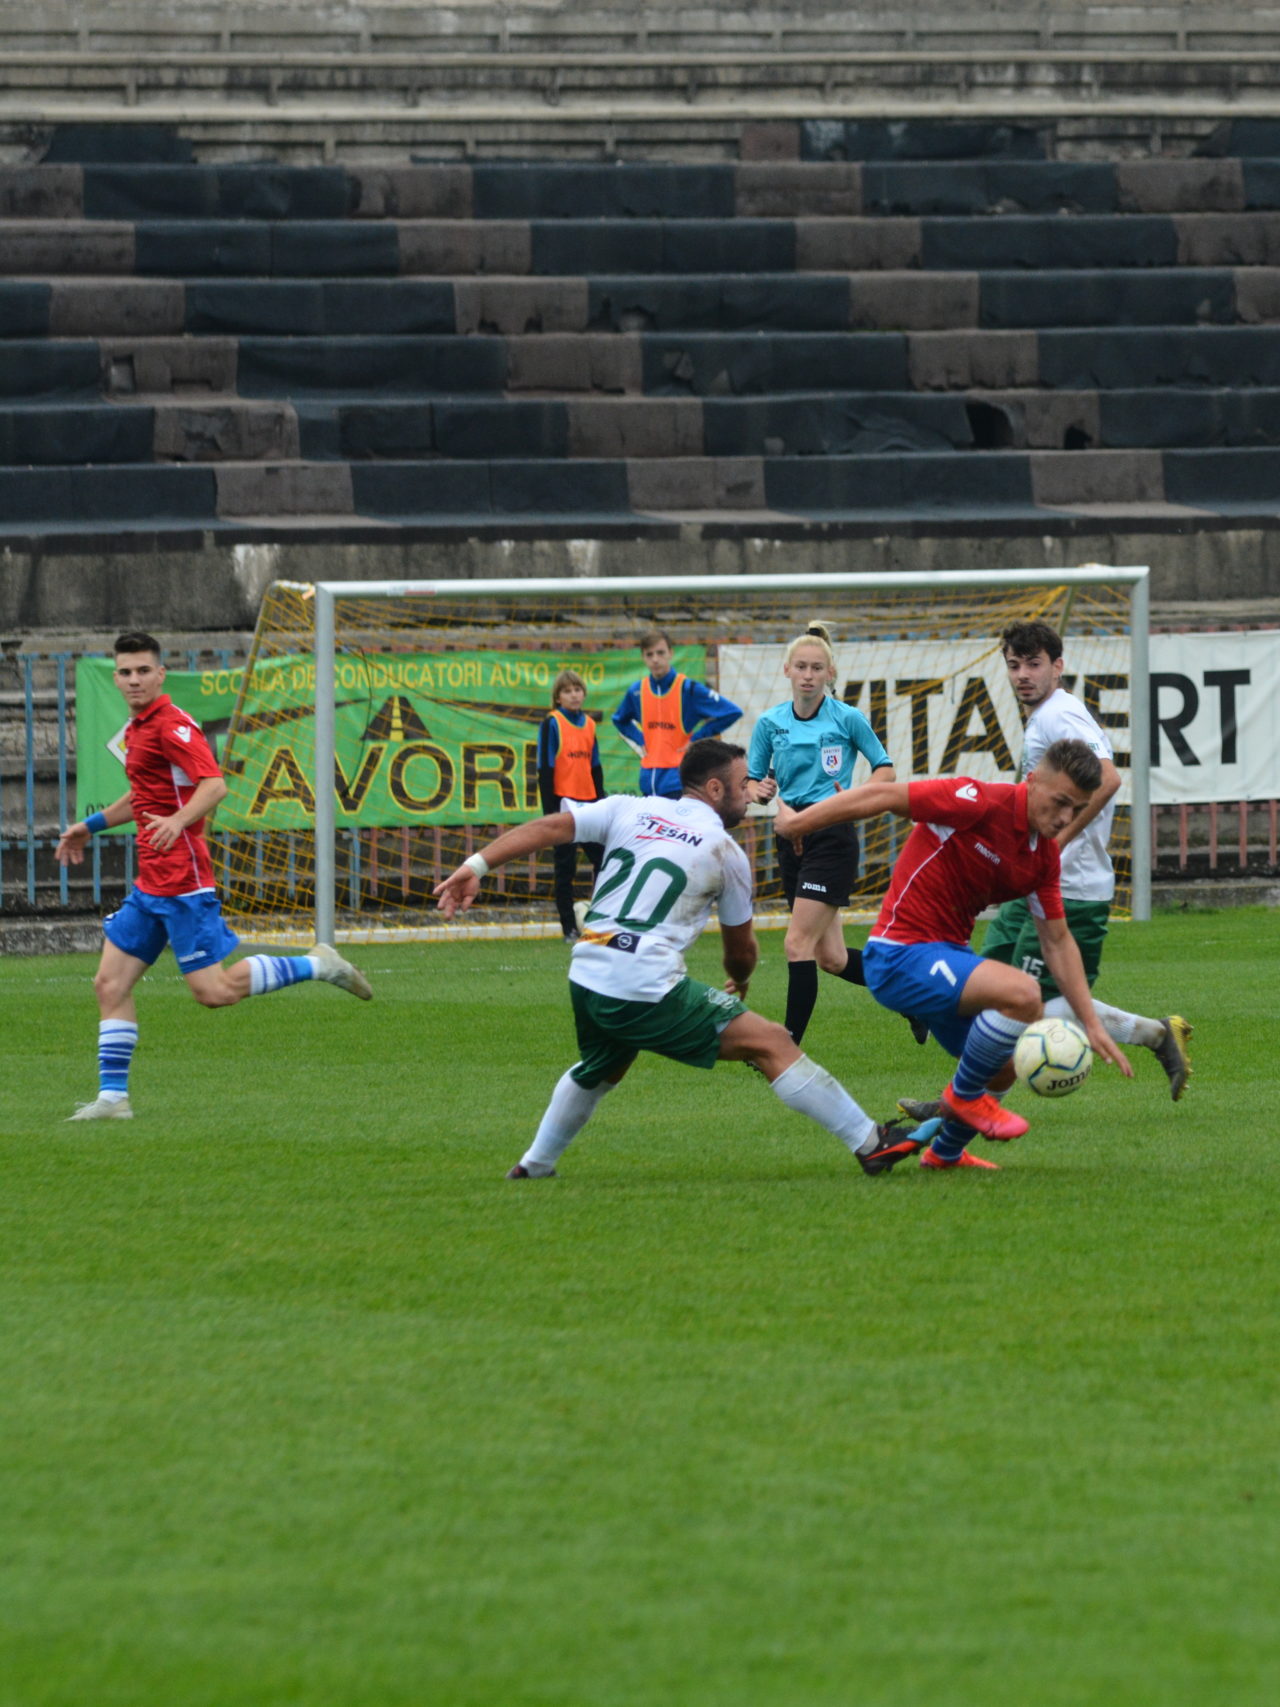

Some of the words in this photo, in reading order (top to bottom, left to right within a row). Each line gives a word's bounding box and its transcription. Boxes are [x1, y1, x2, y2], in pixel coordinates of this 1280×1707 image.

[334, 662, 482, 690] ONDUCATORI
[490, 661, 549, 687] AUTO
[647, 819, 703, 847] TESAN
[584, 847, 687, 932] 20
[929, 959, 958, 987] 7
[1020, 955, 1044, 980] 15
